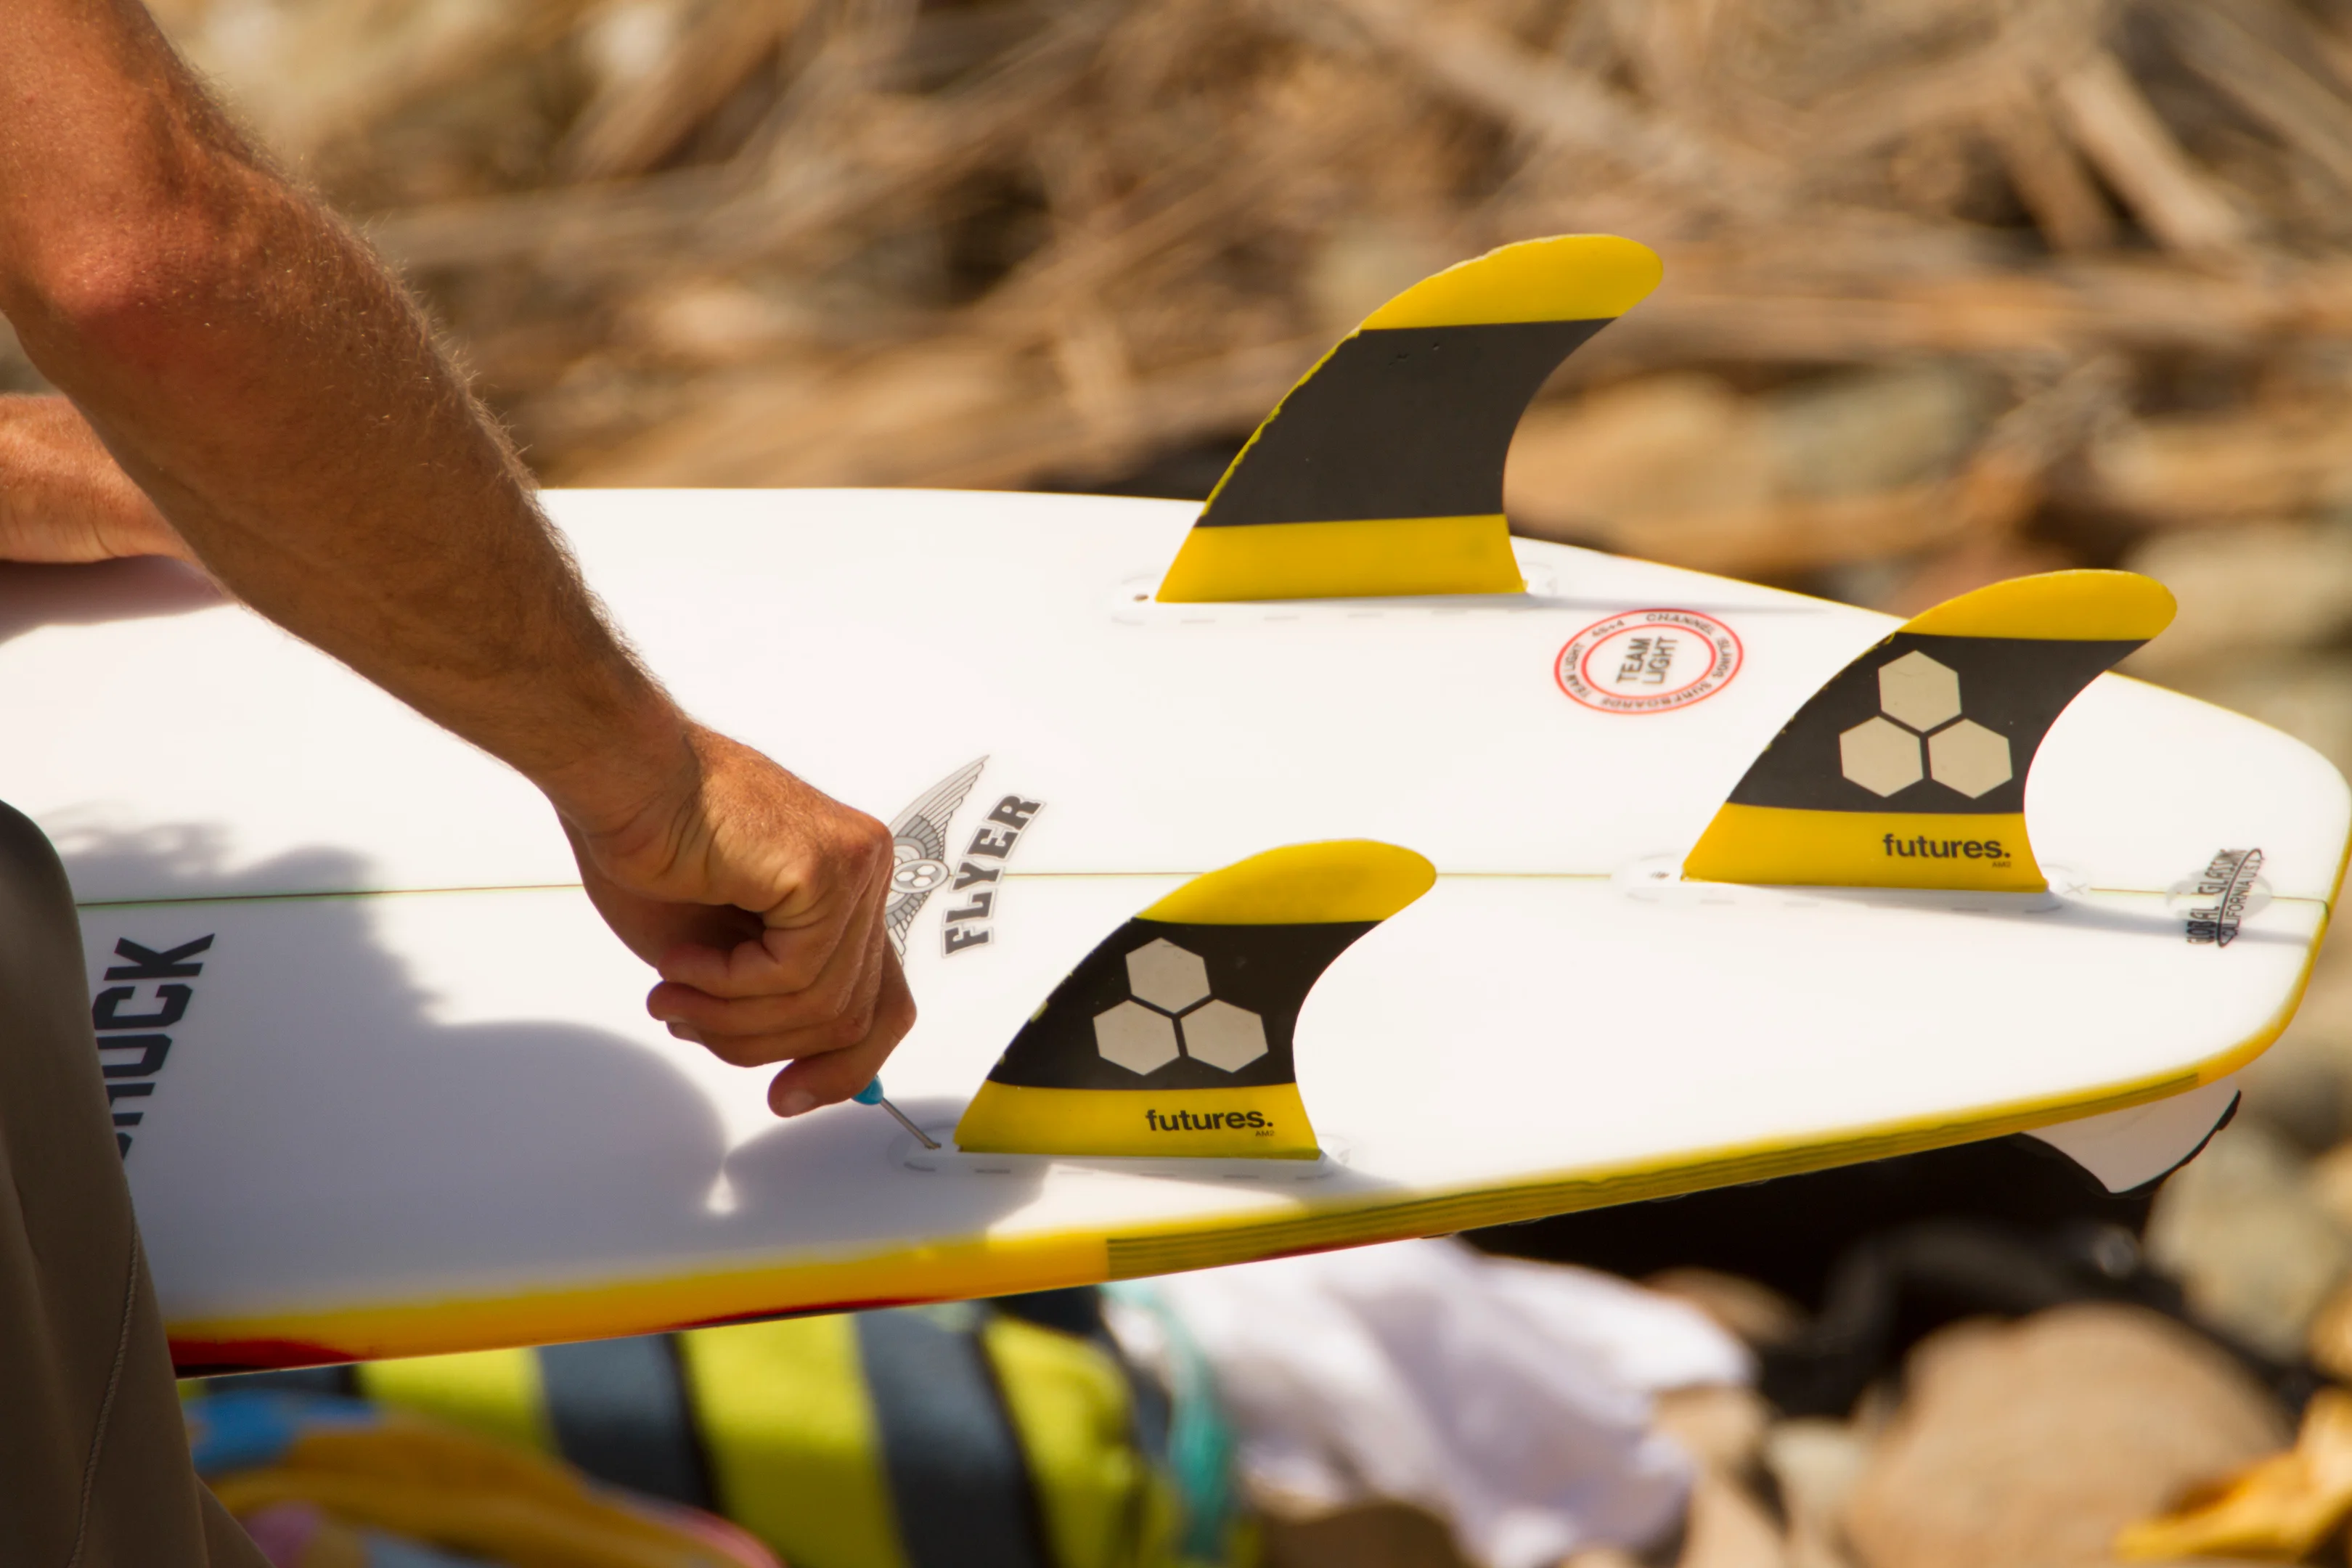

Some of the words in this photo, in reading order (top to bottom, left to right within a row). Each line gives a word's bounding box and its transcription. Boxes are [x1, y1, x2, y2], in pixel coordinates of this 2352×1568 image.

[1646, 613, 1715, 637] CHANNEL
[1564, 642, 1585, 672] LIGHT
[1616, 637, 1652, 684] TEAM
[1642, 636, 1678, 685] LIGHT
[1566, 674, 1592, 698] TEAM
[1882, 833, 2011, 859] futures.
[942, 794, 1045, 957] FLYER
[91, 933, 216, 1160] UCK
[1145, 1108, 1274, 1132] futures.
